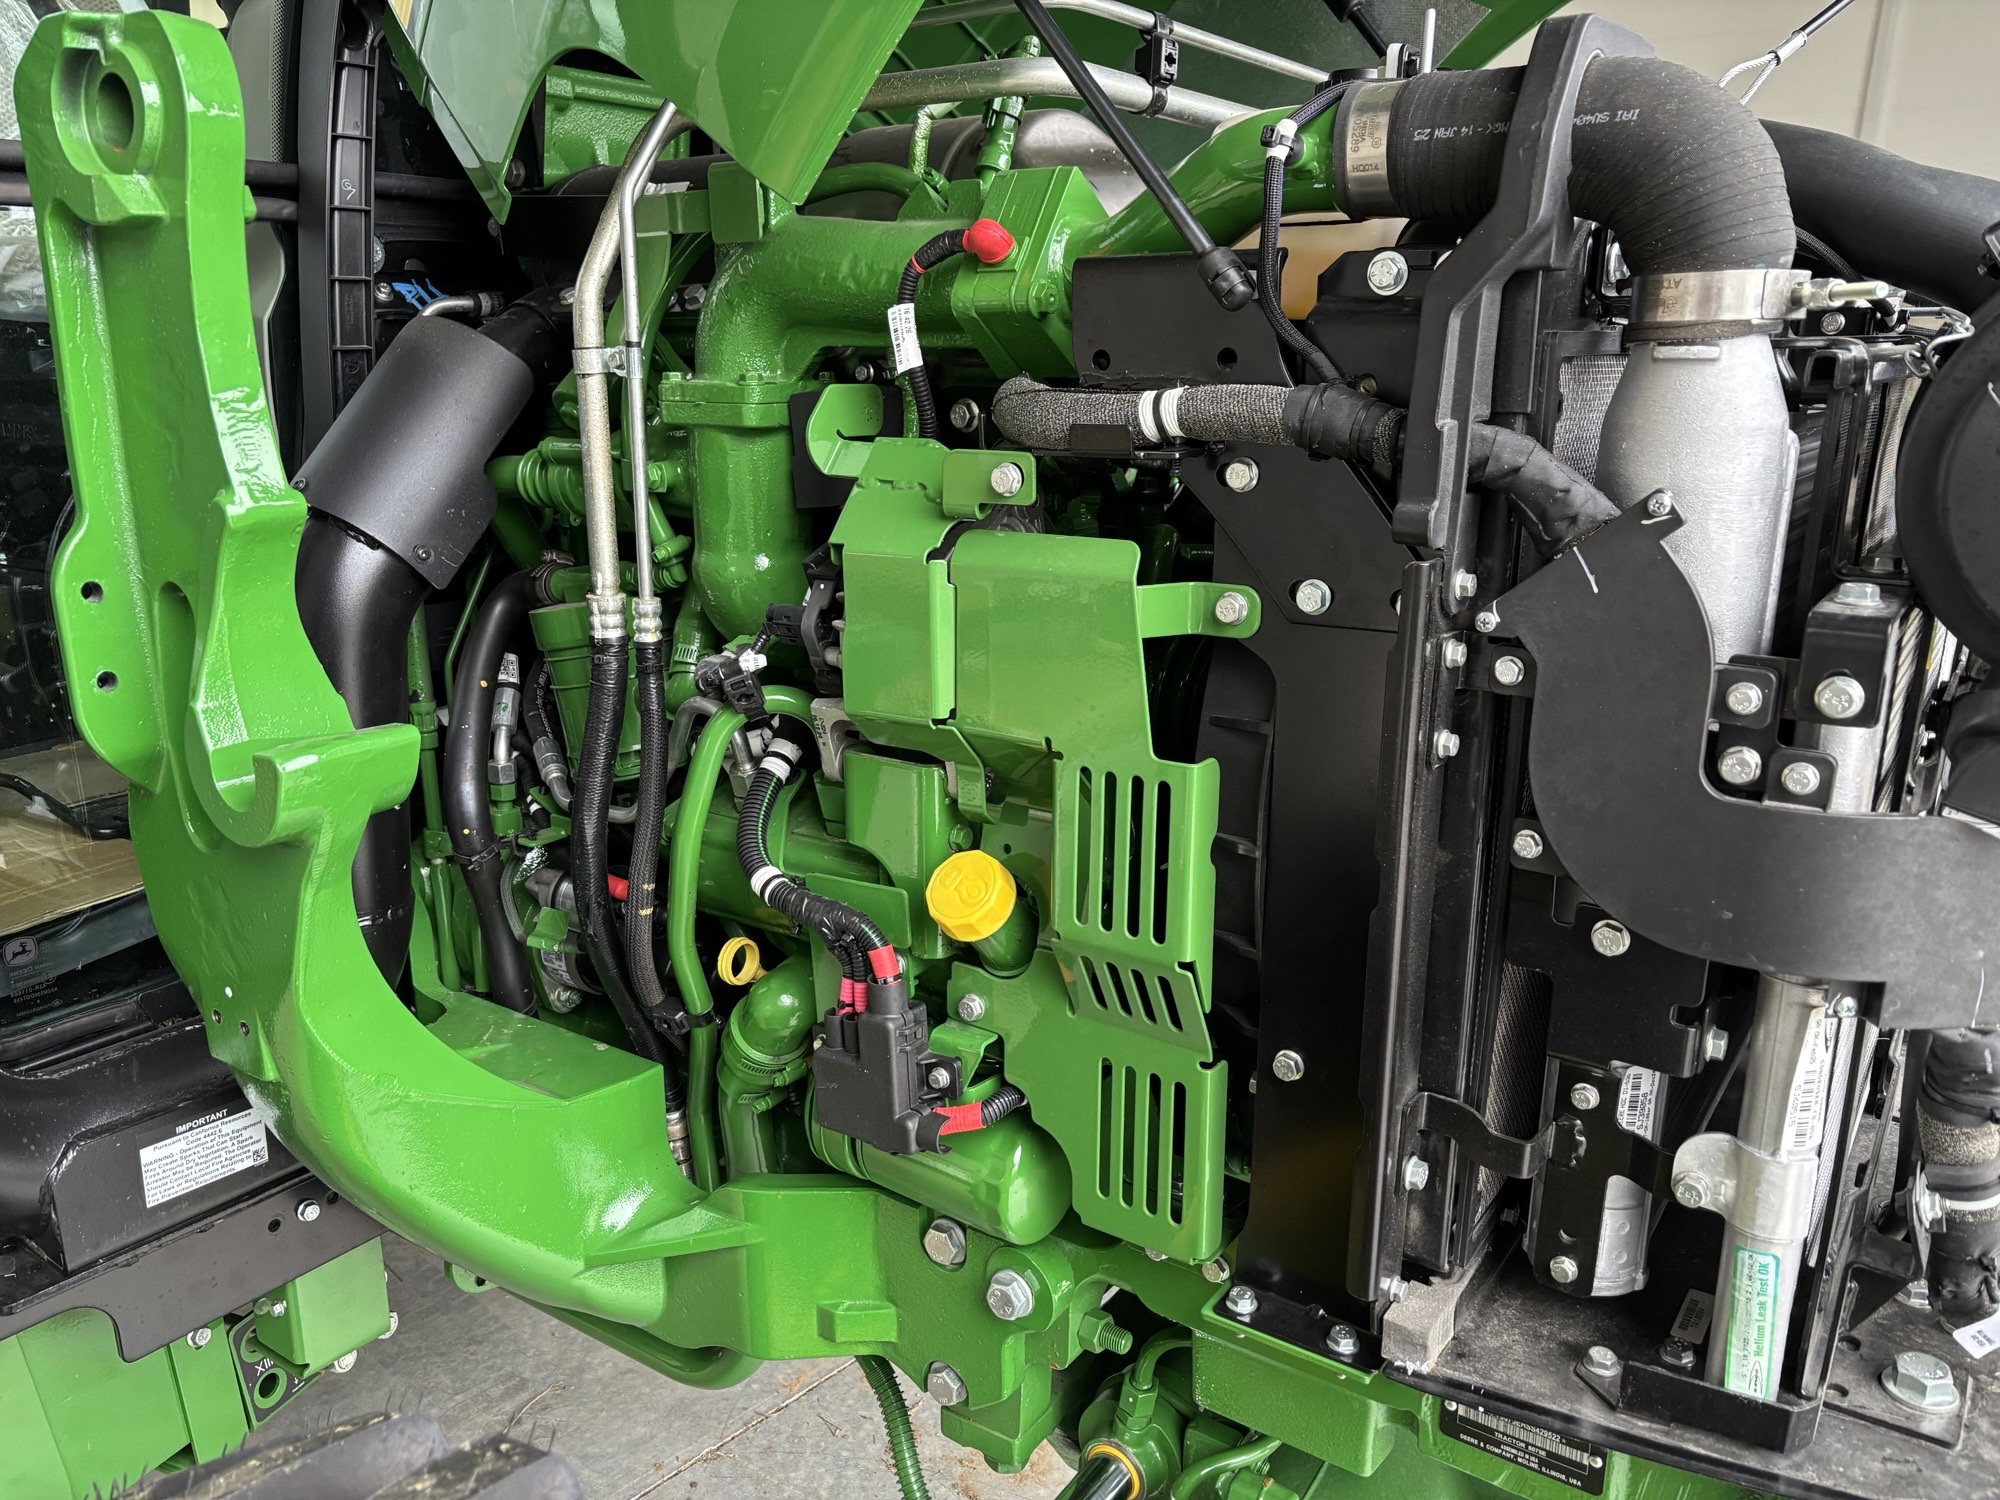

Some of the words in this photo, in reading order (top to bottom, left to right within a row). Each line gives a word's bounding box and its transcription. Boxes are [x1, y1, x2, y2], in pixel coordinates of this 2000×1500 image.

[1350, 118, 1361, 152] 05289
[1413, 128, 1431, 140] 25
[1433, 126, 1457, 138] JAN
[1461, 124, 1473, 135] 14
[153, 1137, 181, 1152] Pursuant
[190, 1123, 218, 1138] California
[220, 1111, 251, 1127] Resources
[175, 1109, 228, 1133] IMPORTANT
[142, 1151, 174, 1168] WARNING
[179, 1138, 208, 1155] Operation
[209, 1135, 216, 1143] of
[217, 1131, 229, 1140] This
[231, 1118, 262, 1135] Equipment
[185, 1135, 201, 1145] Code
[203, 1127, 222, 1139] 4442.6
[143, 1165, 156, 1175] May
[158, 1157, 178, 1169] Create
[179, 1149, 200, 1162] Sparks
[202, 1143, 214, 1152] That
[216, 1138, 227, 1147] Can
[229, 1132, 243, 1142] Start
[144, 1170, 159, 1180] Fires
[161, 1160, 184, 1174] Around
[185, 1156, 196, 1165] Dry
[236, 1134, 253, 1146] Spark
[145, 1172, 170, 1186] Arrestor
[172, 1167, 184, 1177] May
[186, 1163, 193, 1171] be
[195, 1152, 223, 1168] Required.
[224, 1148, 234, 1156] The
[236, 1137, 262, 1152] Operator
[146, 1180, 168, 1192] Should
[169, 1170, 192, 1184] Contact
[194, 1163, 210, 1174] Local
[211, 1158, 223, 1167] Fire
[224, 1148, 250, 1163] Agencies
[146, 1190, 157, 1198] For
[158, 1183, 174, 1194] Laws
[184, 1166, 219, 1184] Regulations
[220, 1156, 244, 1170] Relating
[147, 1196, 159, 1205] Fire
[161, 1182, 193, 1200] Prevention
[1757, 1261, 1769, 1275] OK
[1756, 1277, 1769, 1297] Test
[1754, 1299, 1768, 1322] Leak
[1753, 1324, 1766, 1356] Helium
[1493, 1431, 1525, 1448] TRACTOR
[1459, 1433, 1478, 1445] DEERE
[1568, 1477, 1581, 1486] USA
[1530, 1455, 1538, 1463] USA
